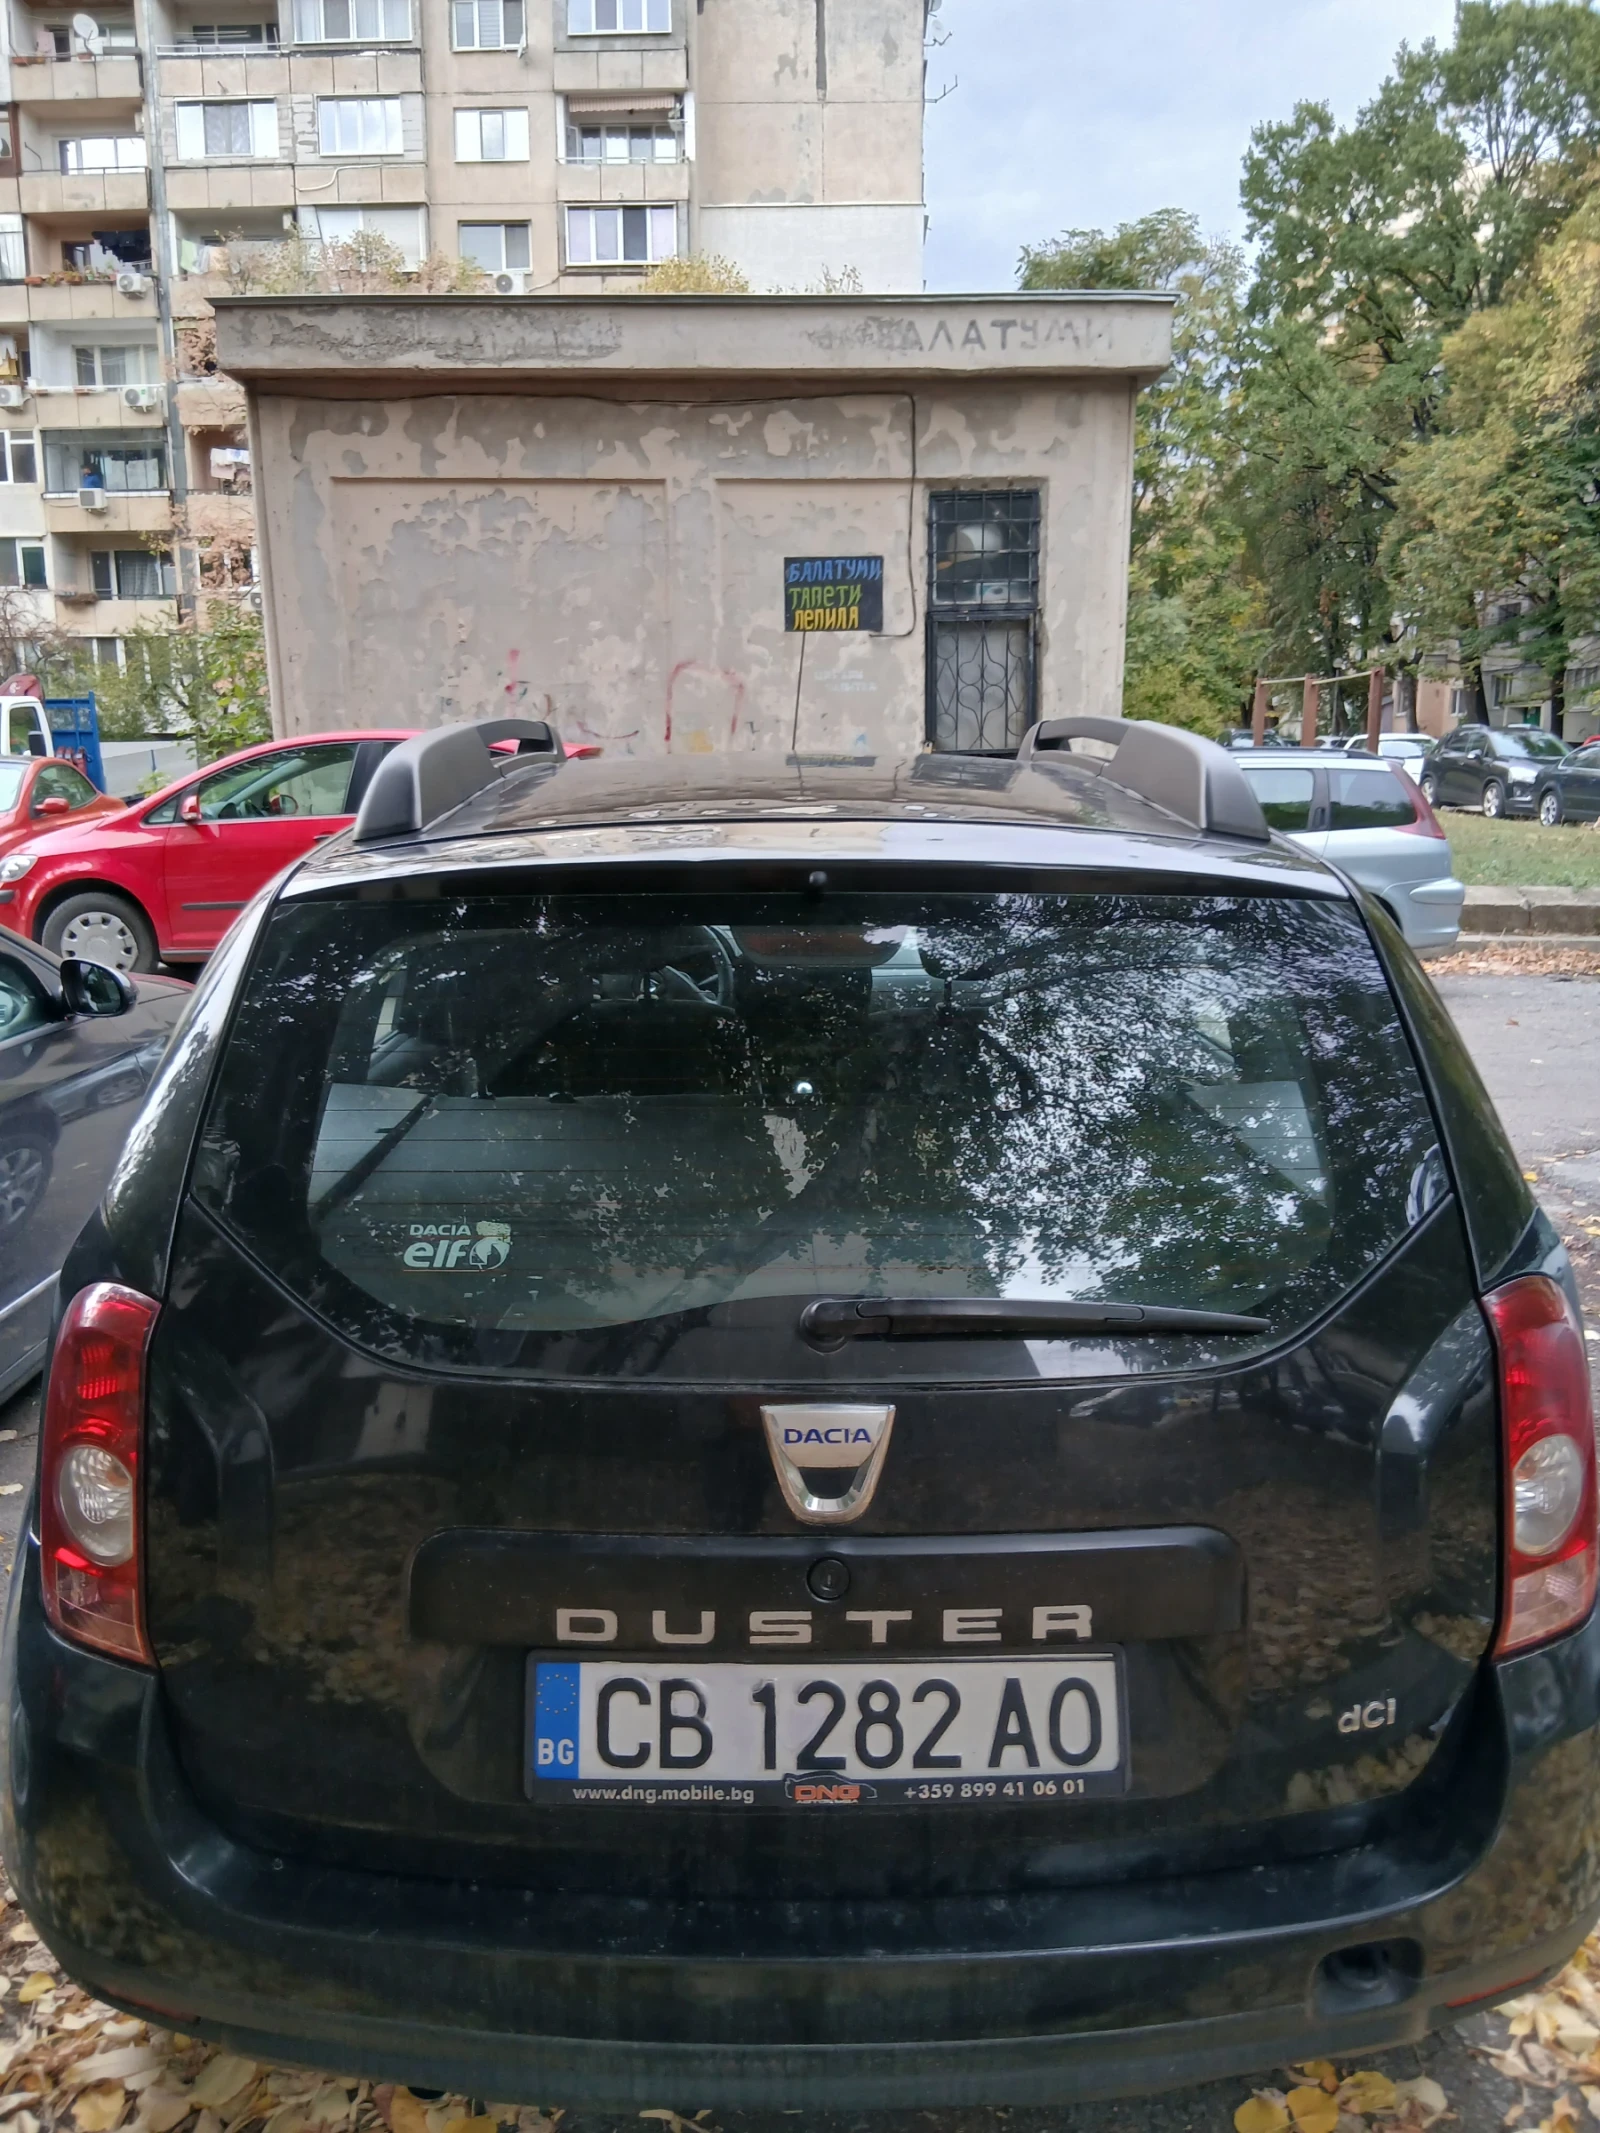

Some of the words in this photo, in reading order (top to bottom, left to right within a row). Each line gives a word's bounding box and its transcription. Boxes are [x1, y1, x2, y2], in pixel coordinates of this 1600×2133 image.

[785, 559, 882, 584] БАЛАТУМИ
[409, 1224, 472, 1236] DACIA
[403, 1239, 472, 1268] elf
[783, 1428, 872, 1444] DACIA
[556, 1605, 1093, 1645] DUSTER
[596, 1677, 714, 1769] CB
[752, 1678, 962, 1770] 1282
[537, 1737, 575, 1766] BG
[572, 1785, 755, 1804] www.dng.mobile.bg
[794, 1784, 861, 1800] DNG
[904, 1784, 953, 1799] +359
[960, 1782, 997, 1798] 899
[1002, 1781, 1025, 1797] 41
[1033, 1780, 1057, 1796] 06
[1063, 1778, 1086, 1794] 01
